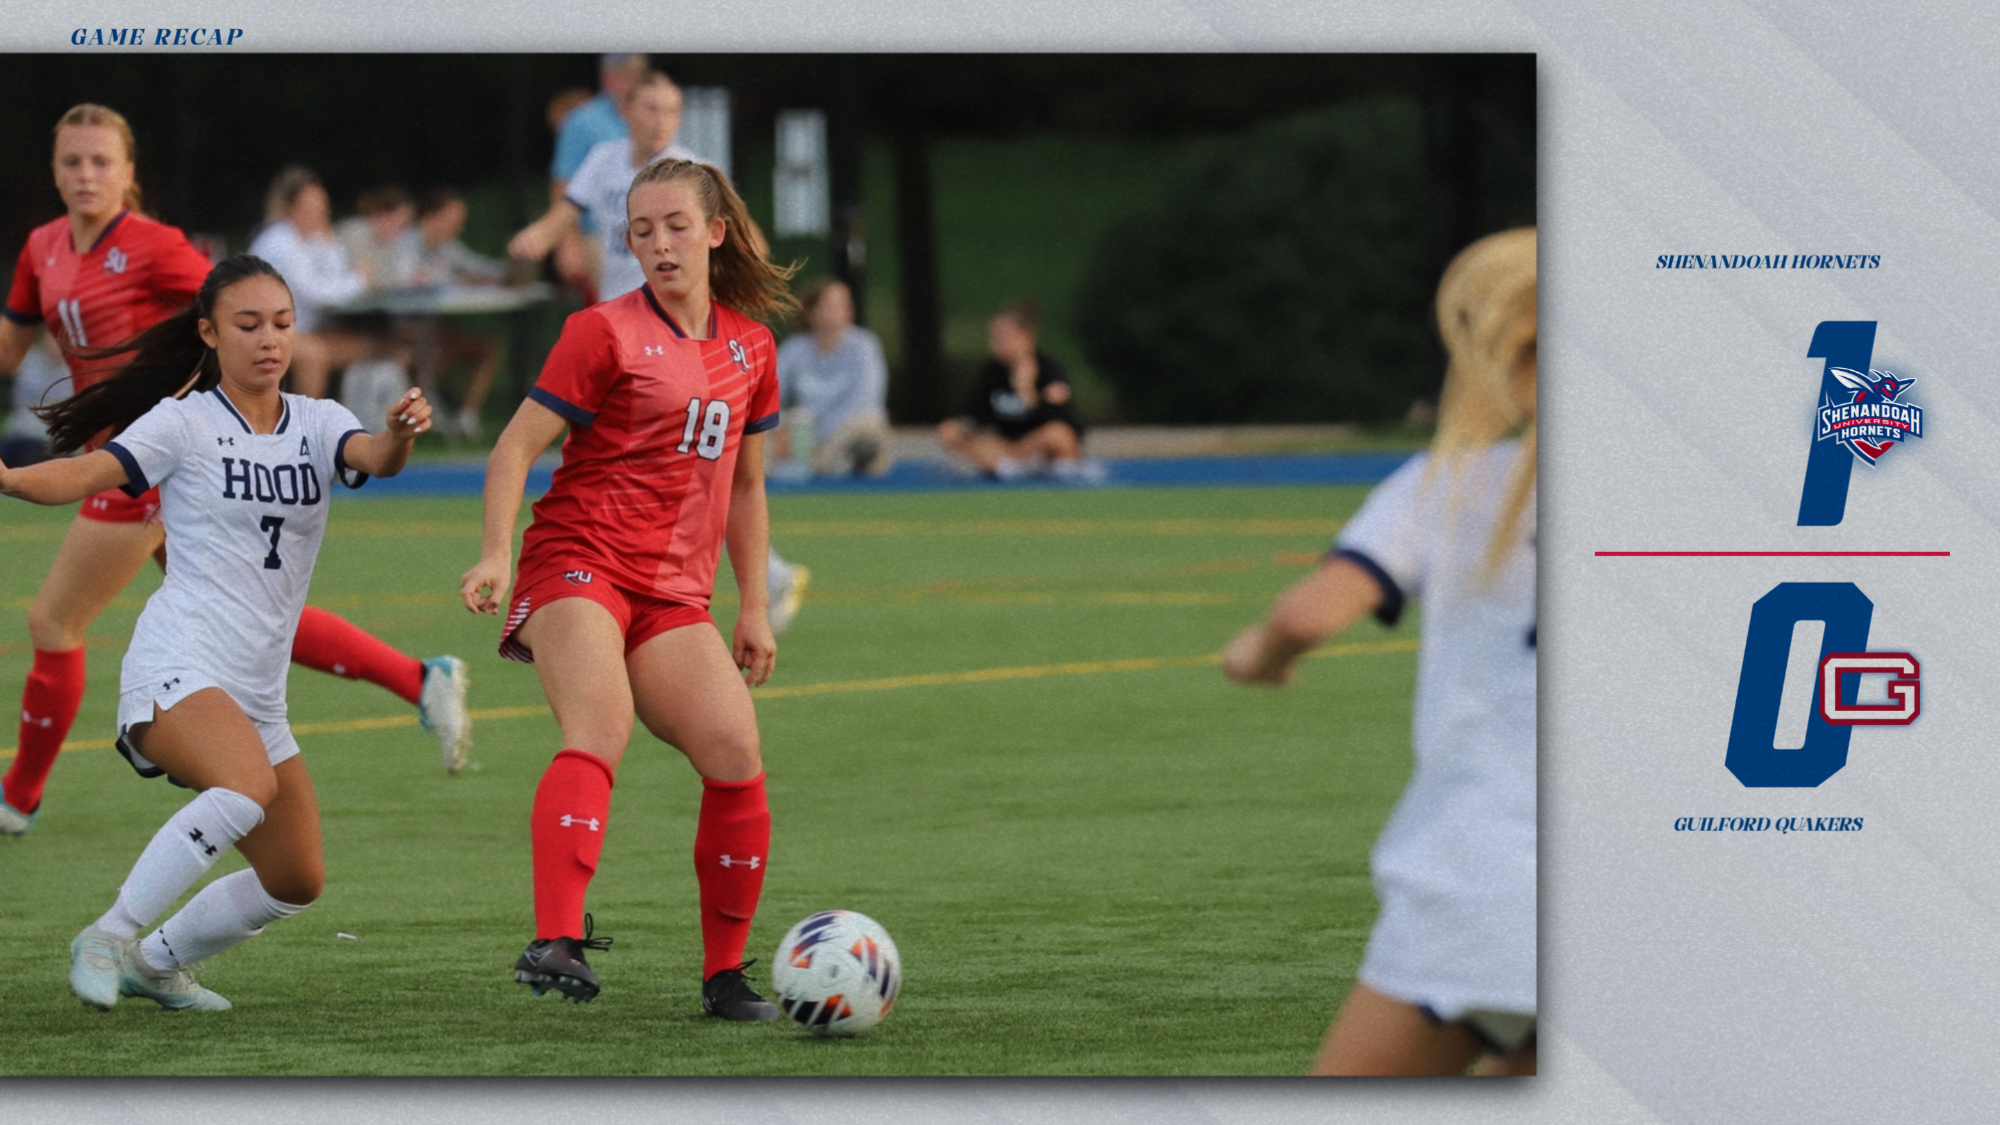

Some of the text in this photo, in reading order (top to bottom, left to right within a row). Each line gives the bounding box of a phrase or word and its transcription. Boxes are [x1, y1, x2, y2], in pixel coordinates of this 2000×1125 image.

[57, 298, 88, 348] 11
[676, 397, 731, 462] 18
[222, 457, 321, 506] HOOD
[260, 515, 285, 570] 7
